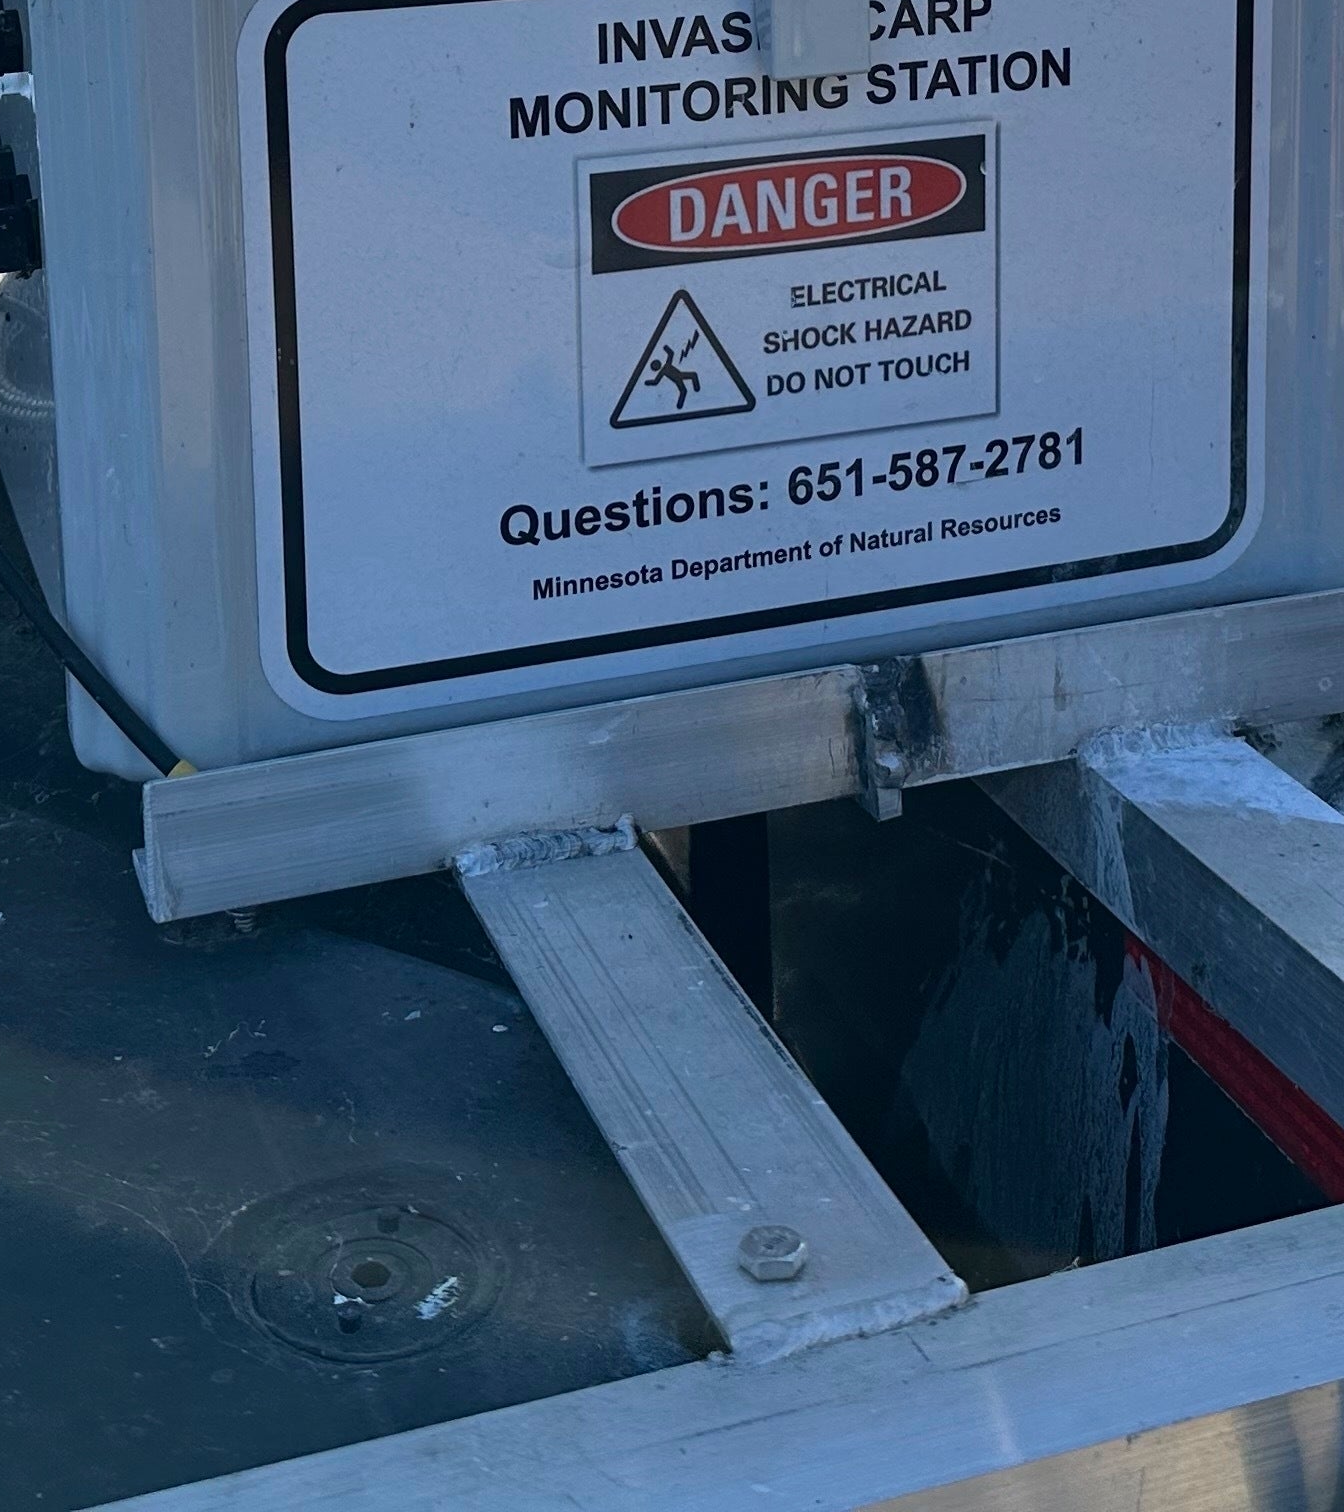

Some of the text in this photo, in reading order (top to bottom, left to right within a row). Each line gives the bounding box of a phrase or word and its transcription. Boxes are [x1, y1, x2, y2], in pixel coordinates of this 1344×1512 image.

[597, 10, 761, 65] INVAS
[510, 47, 1071, 140] MONITORING STATION
[669, 165, 913, 243] DANGER
[790, 270, 947, 309] ELECTRICAL
[763, 308, 972, 355] SHOCK HAZARD
[766, 349, 970, 397] DO NOT TOUCH
[499, 426, 1084, 546] Questions: 651-587-2781
[533, 507, 1062, 601] Minnesota Department of Natural Resources
